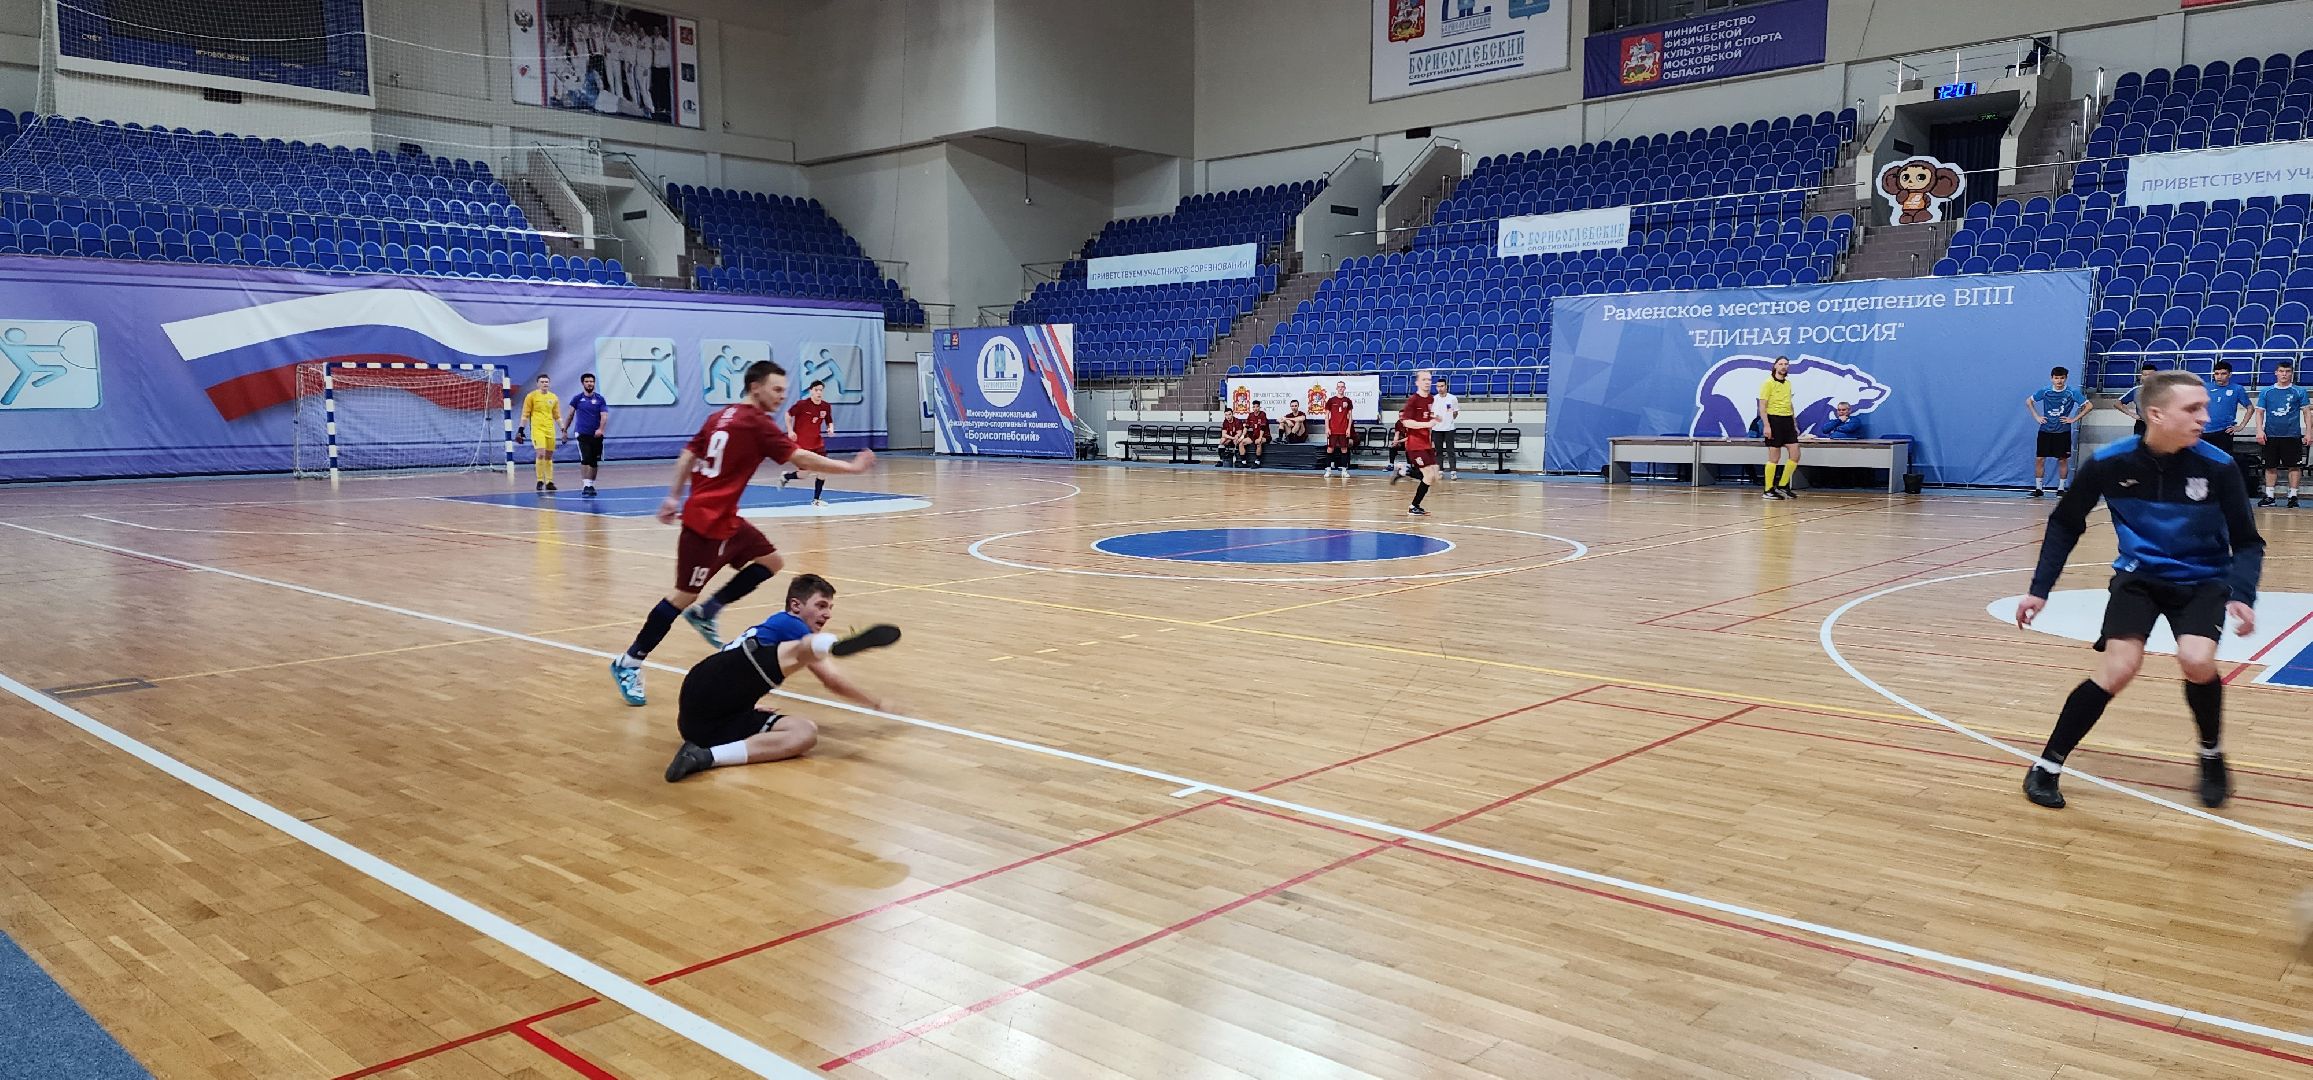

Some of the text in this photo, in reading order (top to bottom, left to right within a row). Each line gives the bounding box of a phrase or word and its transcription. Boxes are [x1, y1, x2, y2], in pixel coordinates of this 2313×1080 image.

[1663, 27, 1742, 48] ФИЗИЧЕСКОЙ
[1664, 15, 1757, 39] МИНИСТЕРСТВО
[1663, 31, 1783, 59] КУЛЬТУРЫ И СПОРТА
[1663, 49, 1742, 70] МОСКОВСКОЙ
[1662, 64, 1715, 80] ОБЛАСТИ
[2141, 167, 2313, 192] ПРИВЕТСТВУЕМ УЧ
[1092, 270, 1143, 281] ПРИВЕТСТВУЕМ
[1144, 266, 1189, 277] УЧАСТНИКОВ
[1602, 285, 2016, 321] Раменское местное отделение ВПП
[1688, 322, 1905, 349] "ЕДИНАЯ РОССИЯ"
[688, 566, 710, 587] 19
